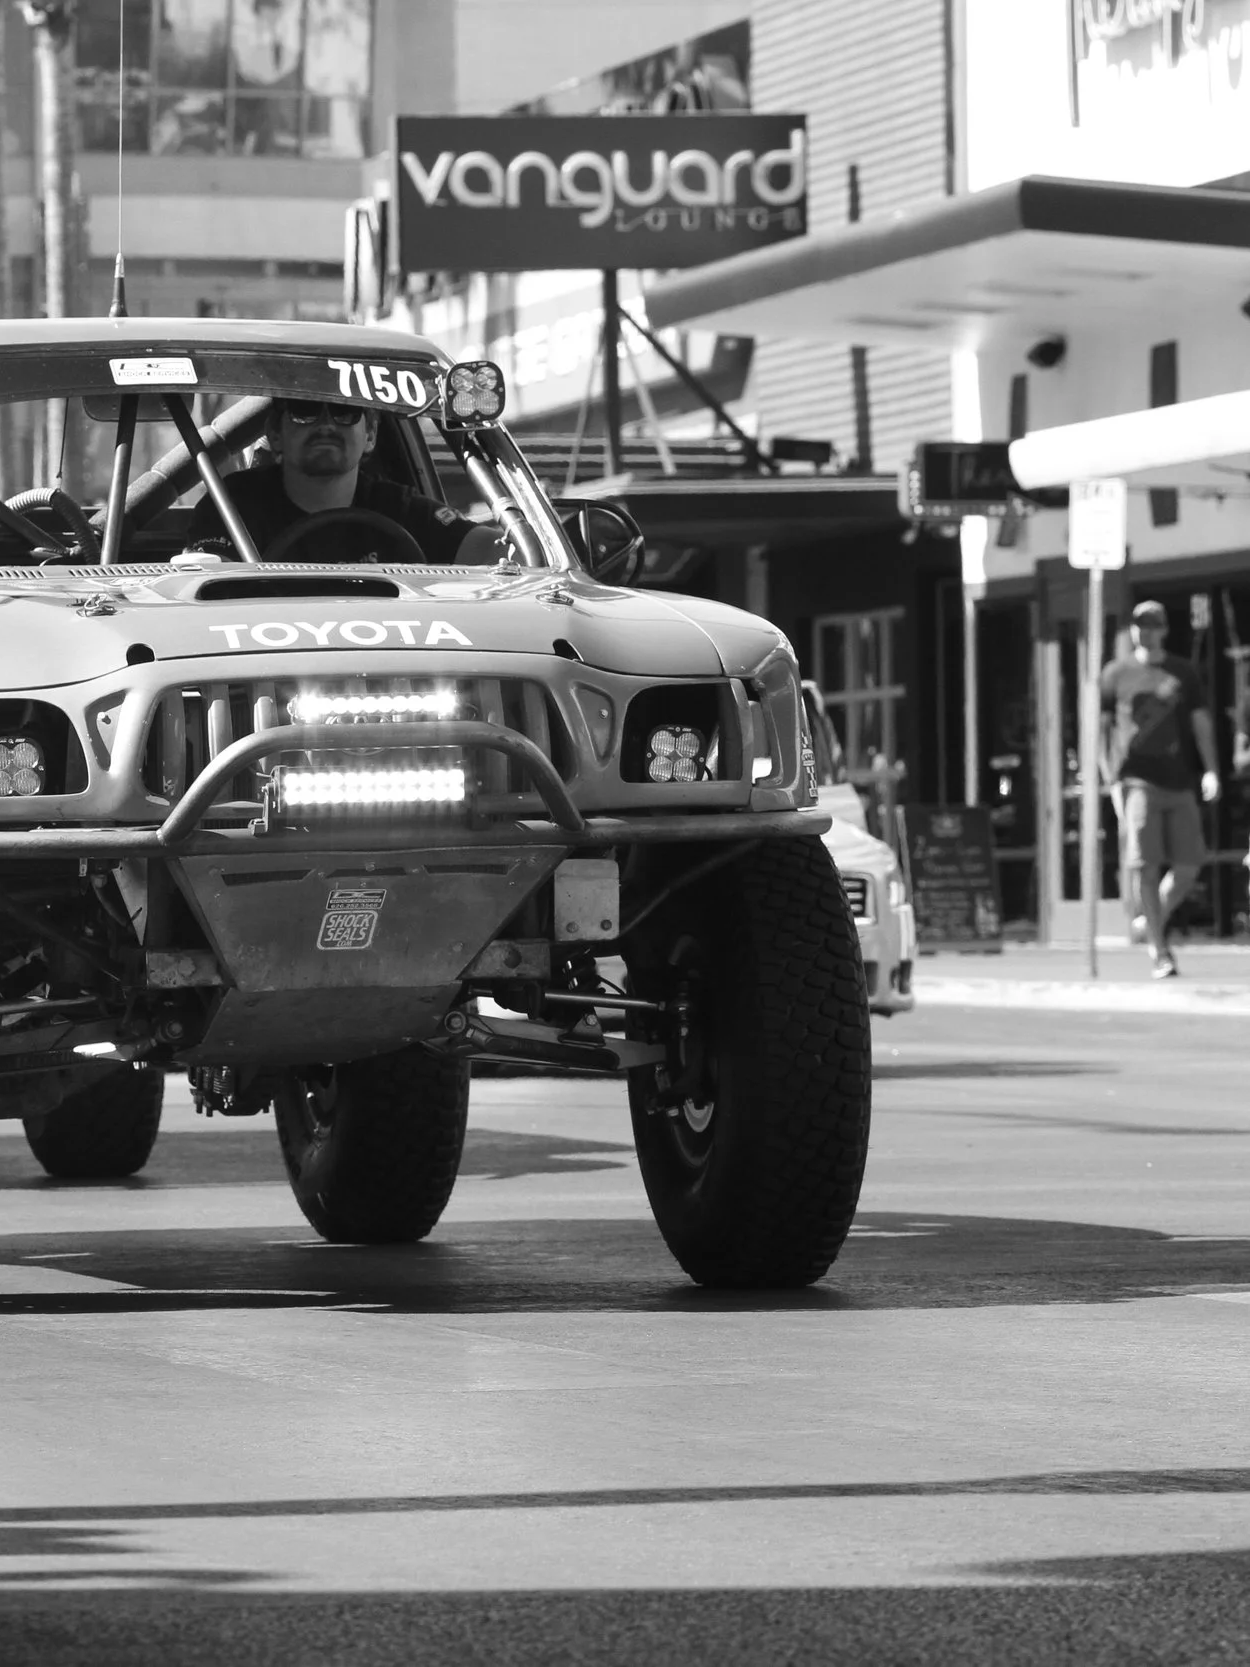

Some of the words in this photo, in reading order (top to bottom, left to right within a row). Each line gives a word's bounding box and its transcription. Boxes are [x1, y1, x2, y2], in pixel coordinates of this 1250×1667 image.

[401, 128, 805, 228] vanguard
[613, 207, 803, 232] LOUNGE
[327, 359, 427, 408] 7150
[208, 620, 474, 649] TOYOTA
[324, 927, 368, 941] SEALS
[326, 914, 373, 928] SHOCK
